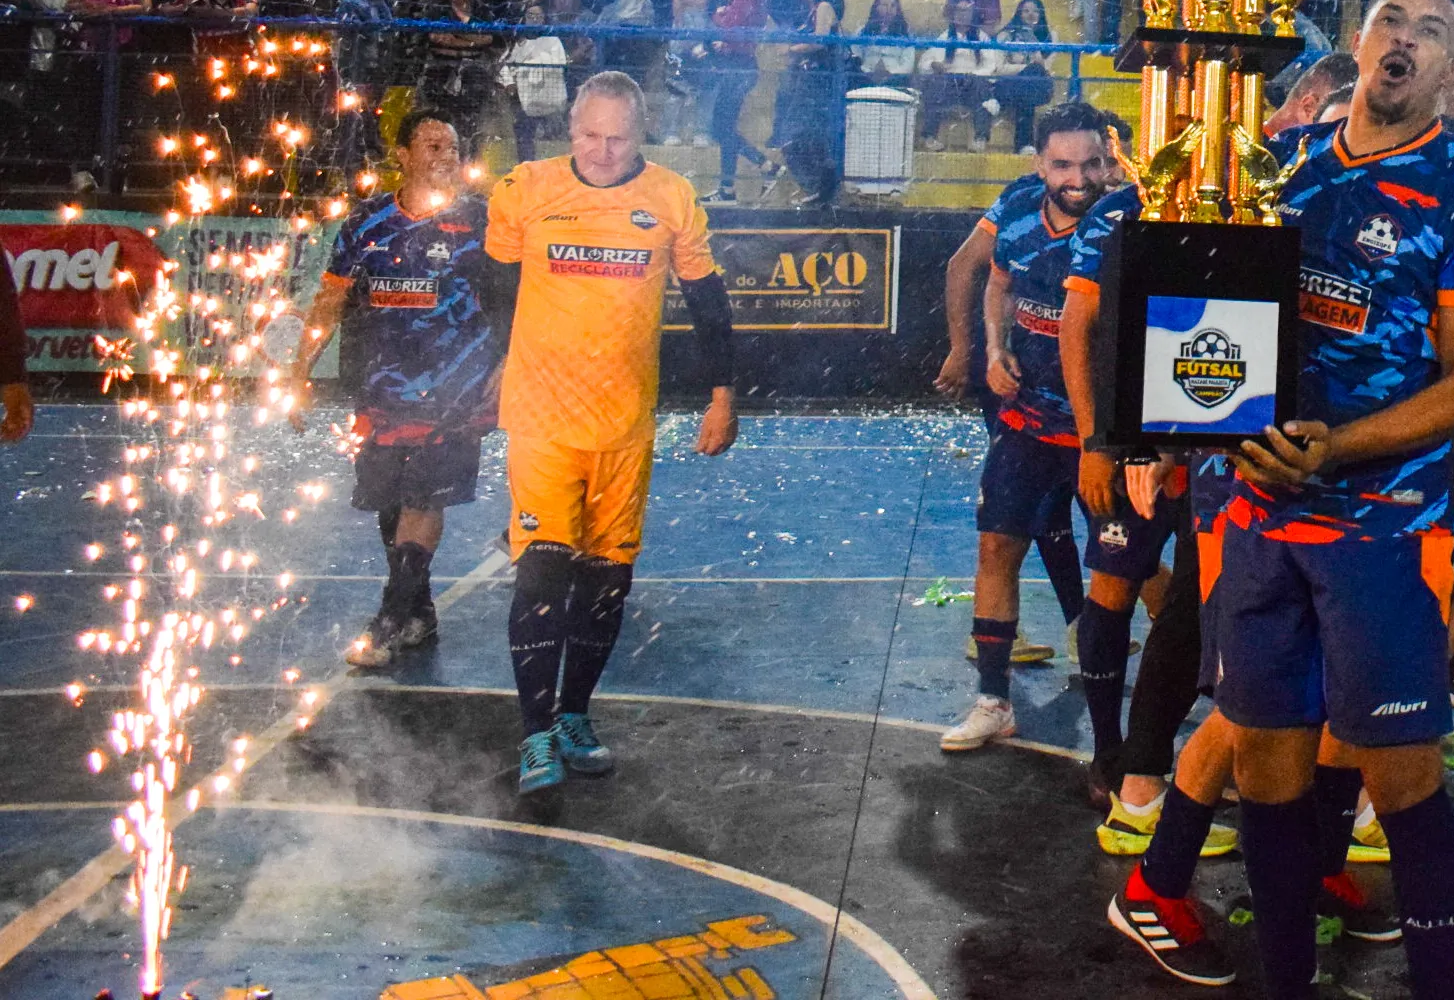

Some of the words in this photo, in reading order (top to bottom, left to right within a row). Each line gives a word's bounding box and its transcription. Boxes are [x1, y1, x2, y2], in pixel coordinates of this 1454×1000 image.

[550, 245, 648, 264] VALORIZE
[550, 262, 646, 278] RECICLAGEM
[735, 274, 757, 287] do
[767, 251, 868, 296] AÇO
[775, 298, 861, 309] IMPORTADO
[1176, 361, 1243, 377] FUTSAL
[1370, 700, 1428, 717] Alluri
